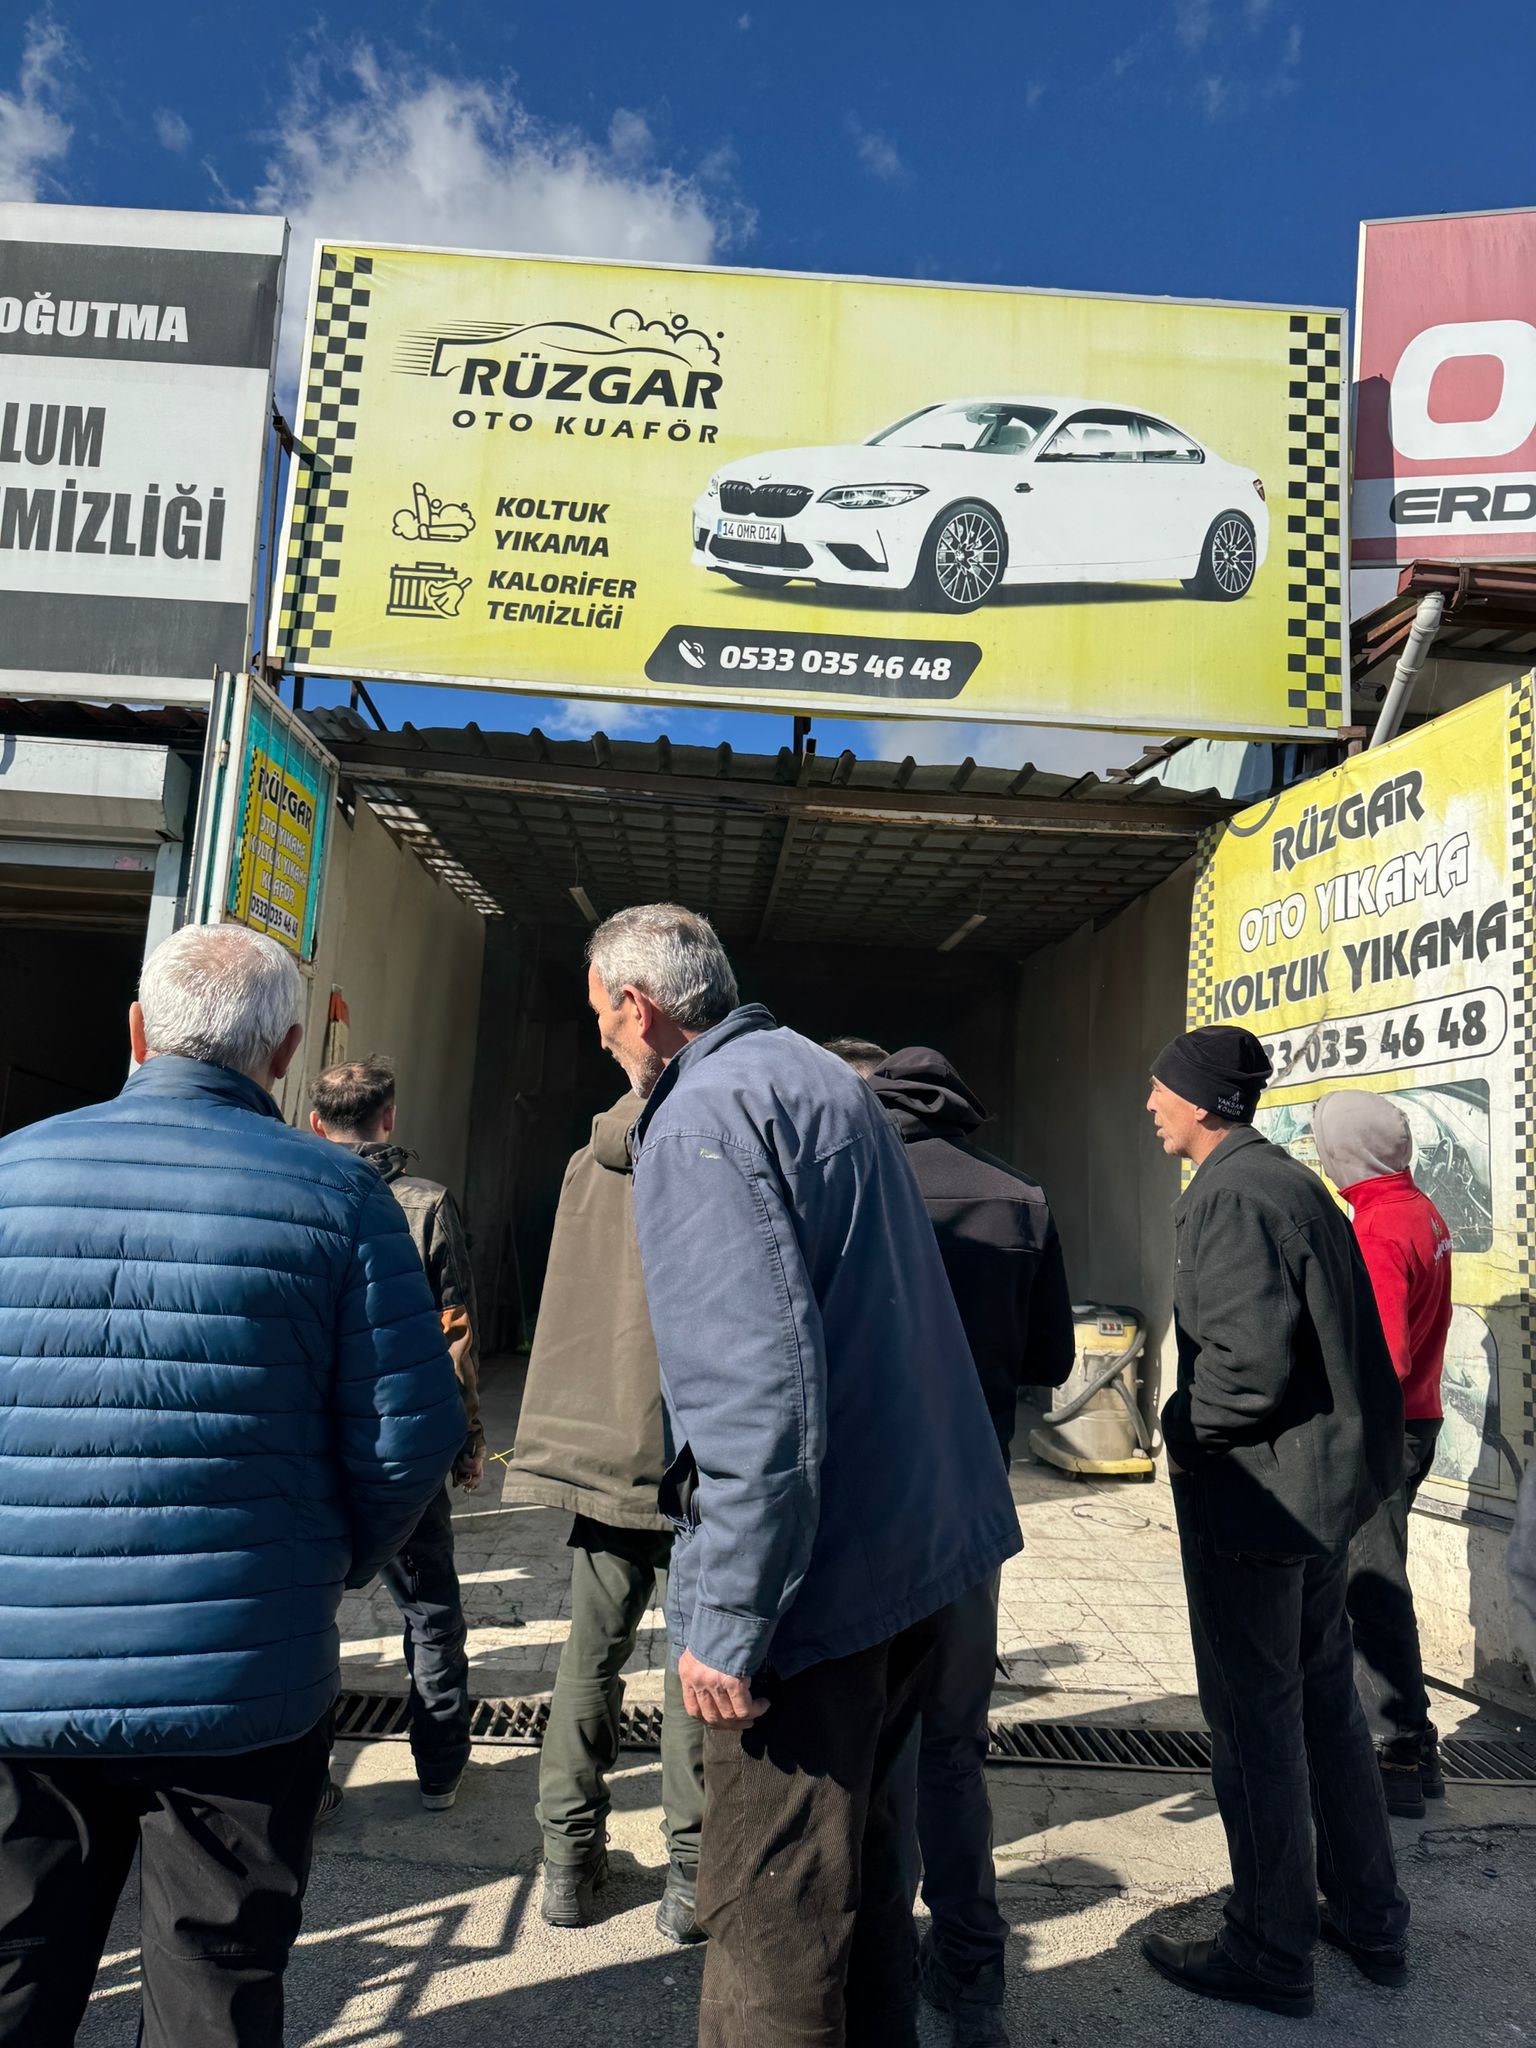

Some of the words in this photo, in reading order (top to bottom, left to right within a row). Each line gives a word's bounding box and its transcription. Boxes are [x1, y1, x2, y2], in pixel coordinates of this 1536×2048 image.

[0, 291, 189, 343] OĞUTMA
[458, 352, 723, 410] RÜZGAR
[0, 402, 106, 468] LUM
[452, 410, 533, 434] OTO
[554, 416, 719, 444] KUAFÖR
[495, 496, 611, 524] KOLTUK
[1389, 485, 1536, 525] ERD
[494, 529, 610, 558] YIKAMA
[722, 522, 734, 537] 14
[737, 523, 756, 541] OMR
[758, 525, 777, 541] 014
[487, 570, 637, 600] KALORİFER
[487, 600, 624, 630] TEMİZLİĞİ
[719, 645, 795, 672] 0533
[801, 649, 859, 676] 035
[863, 654, 905, 680] 46
[909, 657, 952, 682] 48
[1272, 770, 1425, 872] RÜZGAR
[1238, 892, 1306, 953] OTO
[1314, 831, 1470, 934] YIKAMA
[1213, 949, 1330, 1023] KOLTUK
[1342, 900, 1508, 994] YIKAMA
[1305, 1025, 1367, 1073] 035
[1380, 1014, 1425, 1060] 46
[1438, 1000, 1487, 1049] 48
